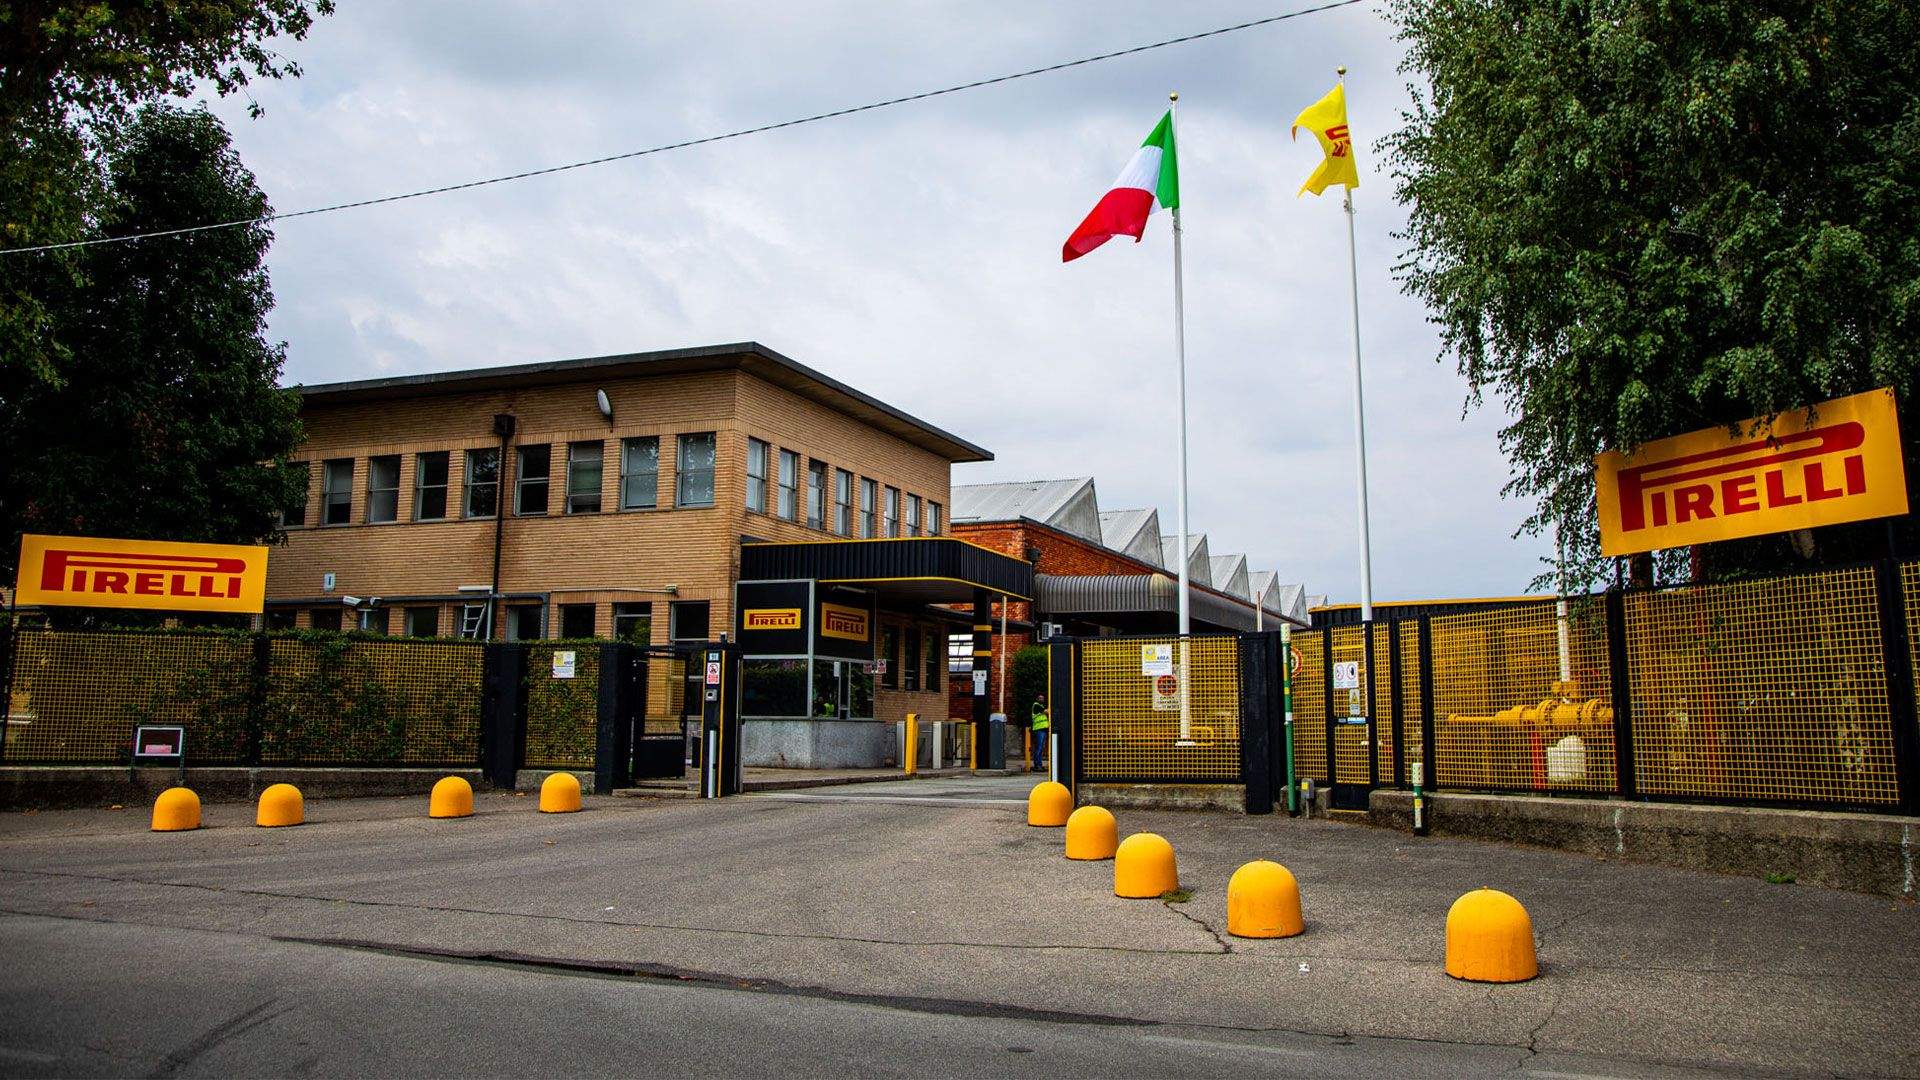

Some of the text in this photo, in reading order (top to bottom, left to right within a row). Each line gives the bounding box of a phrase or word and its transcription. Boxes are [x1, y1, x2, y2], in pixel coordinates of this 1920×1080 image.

[1617, 421, 1866, 532] PIRELLI
[41, 549, 246, 599] PIRELLI
[749, 612, 796, 626] PIRELLI
[825, 609, 866, 635] PIRELLI
